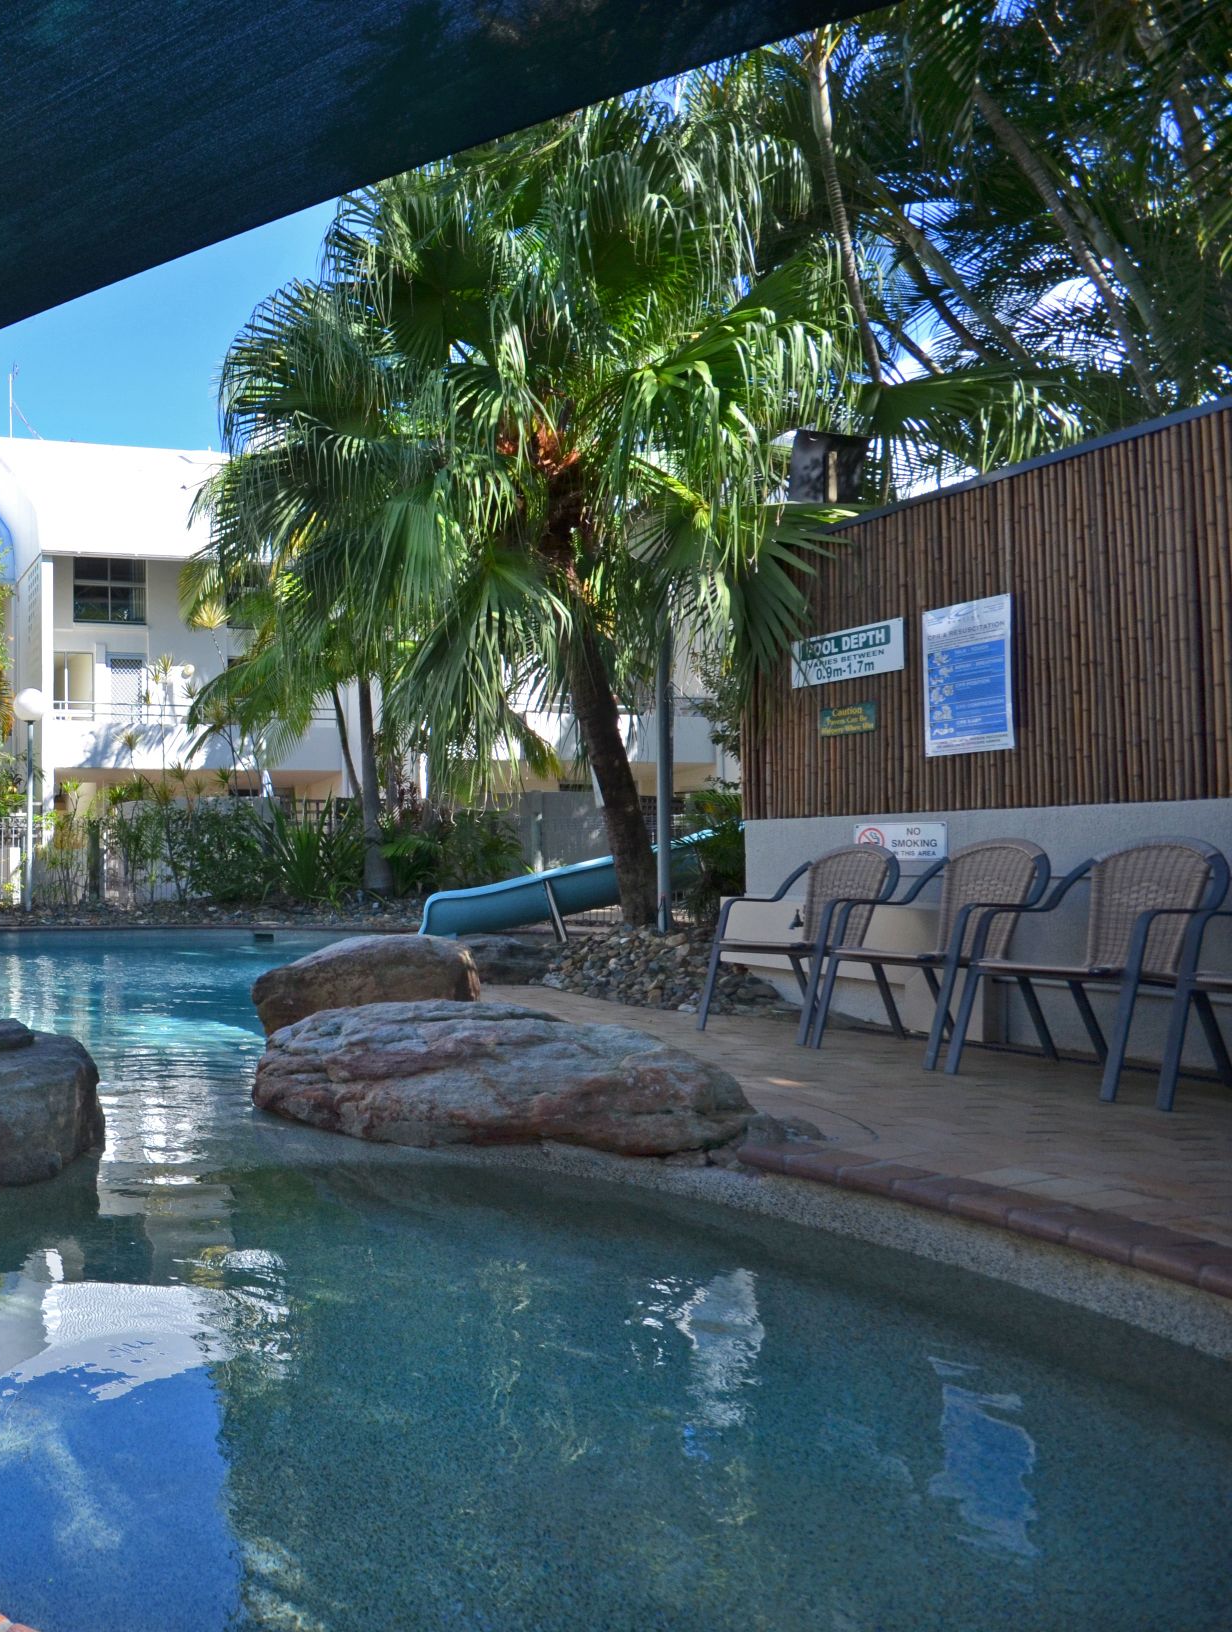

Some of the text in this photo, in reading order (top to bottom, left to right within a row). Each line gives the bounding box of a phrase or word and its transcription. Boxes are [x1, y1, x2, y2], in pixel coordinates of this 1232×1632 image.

[949, 621, 1005, 635] RESUSCITATION
[806, 629, 885, 658] POOL DEPTH
[807, 649, 885, 669] VARIES BETWEEN
[816, 661, 875, 680] 0.9m-1.7m
[832, 706, 862, 717] Caution
[906, 827, 921, 836] NO
[891, 839, 938, 848] SMOKING
